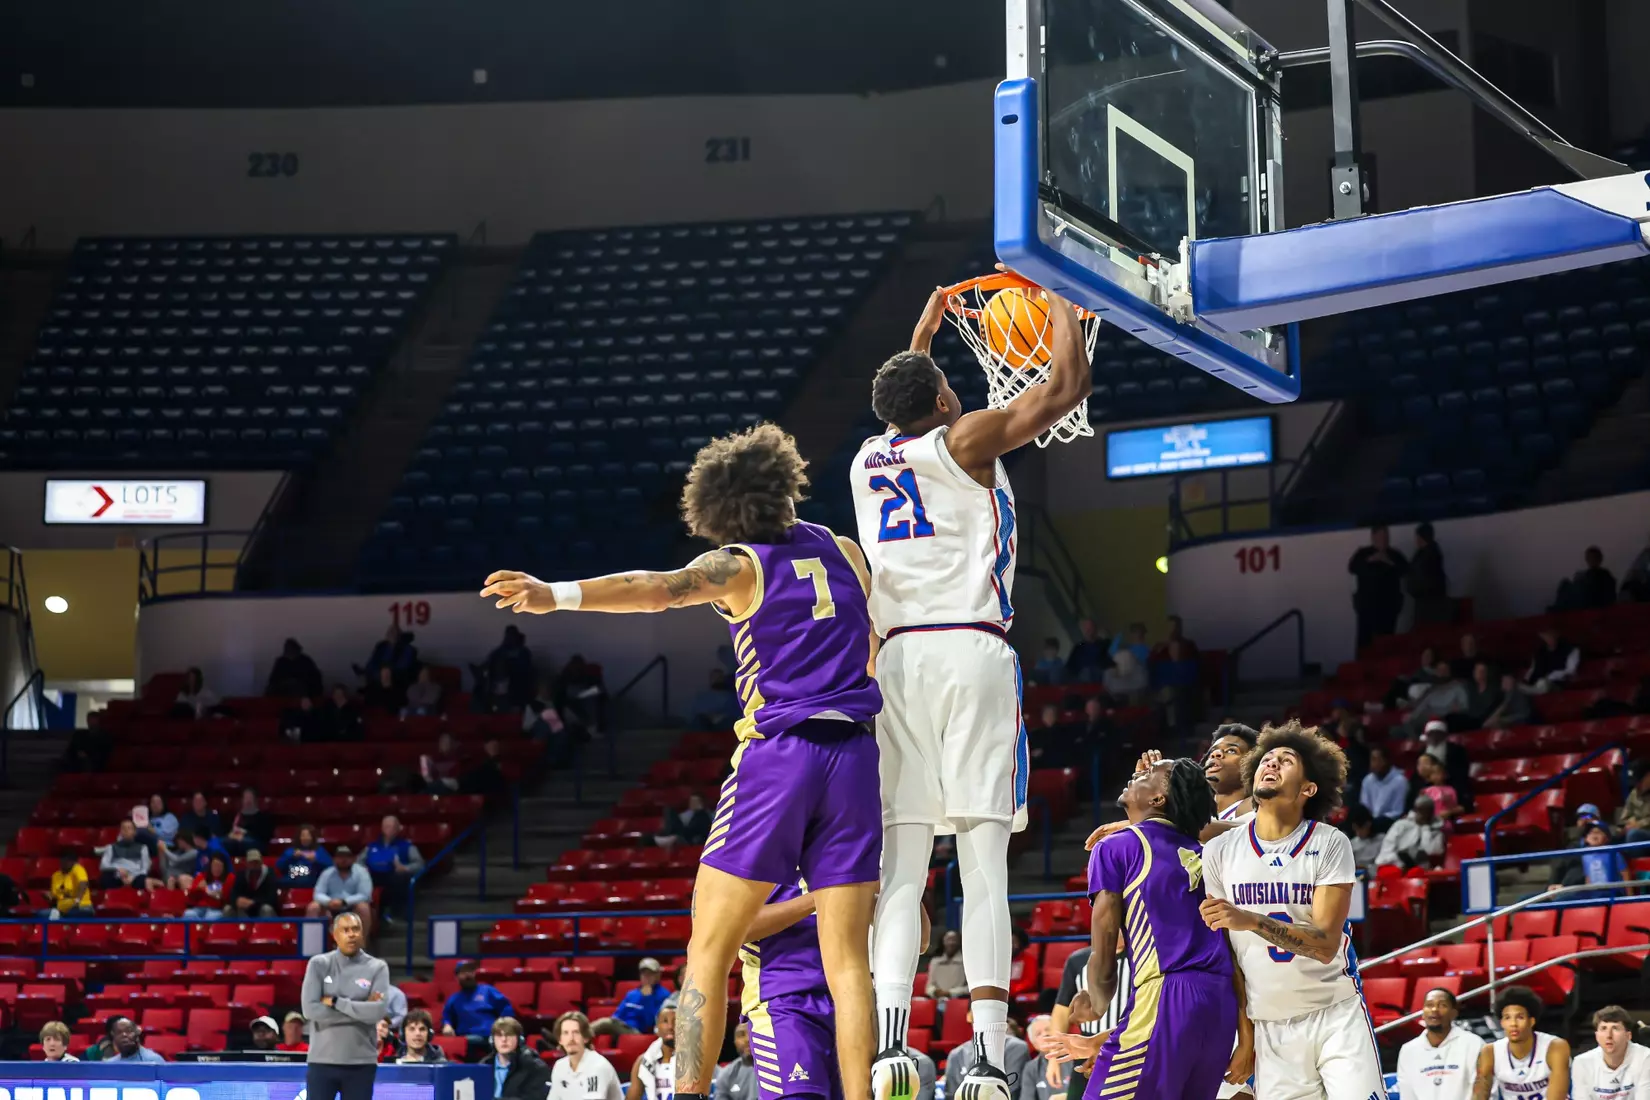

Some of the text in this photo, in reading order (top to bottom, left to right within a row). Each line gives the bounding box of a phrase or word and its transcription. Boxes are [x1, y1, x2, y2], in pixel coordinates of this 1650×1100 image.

[705, 136, 752, 164] 231
[248, 151, 299, 178] 230
[122, 485, 178, 504] LOTS
[868, 467, 936, 543] 21
[1233, 544, 1281, 575] 101
[791, 556, 836, 620] 7
[388, 600, 432, 627] 119
[1231, 882, 1313, 906] LOUISIANA TEC
